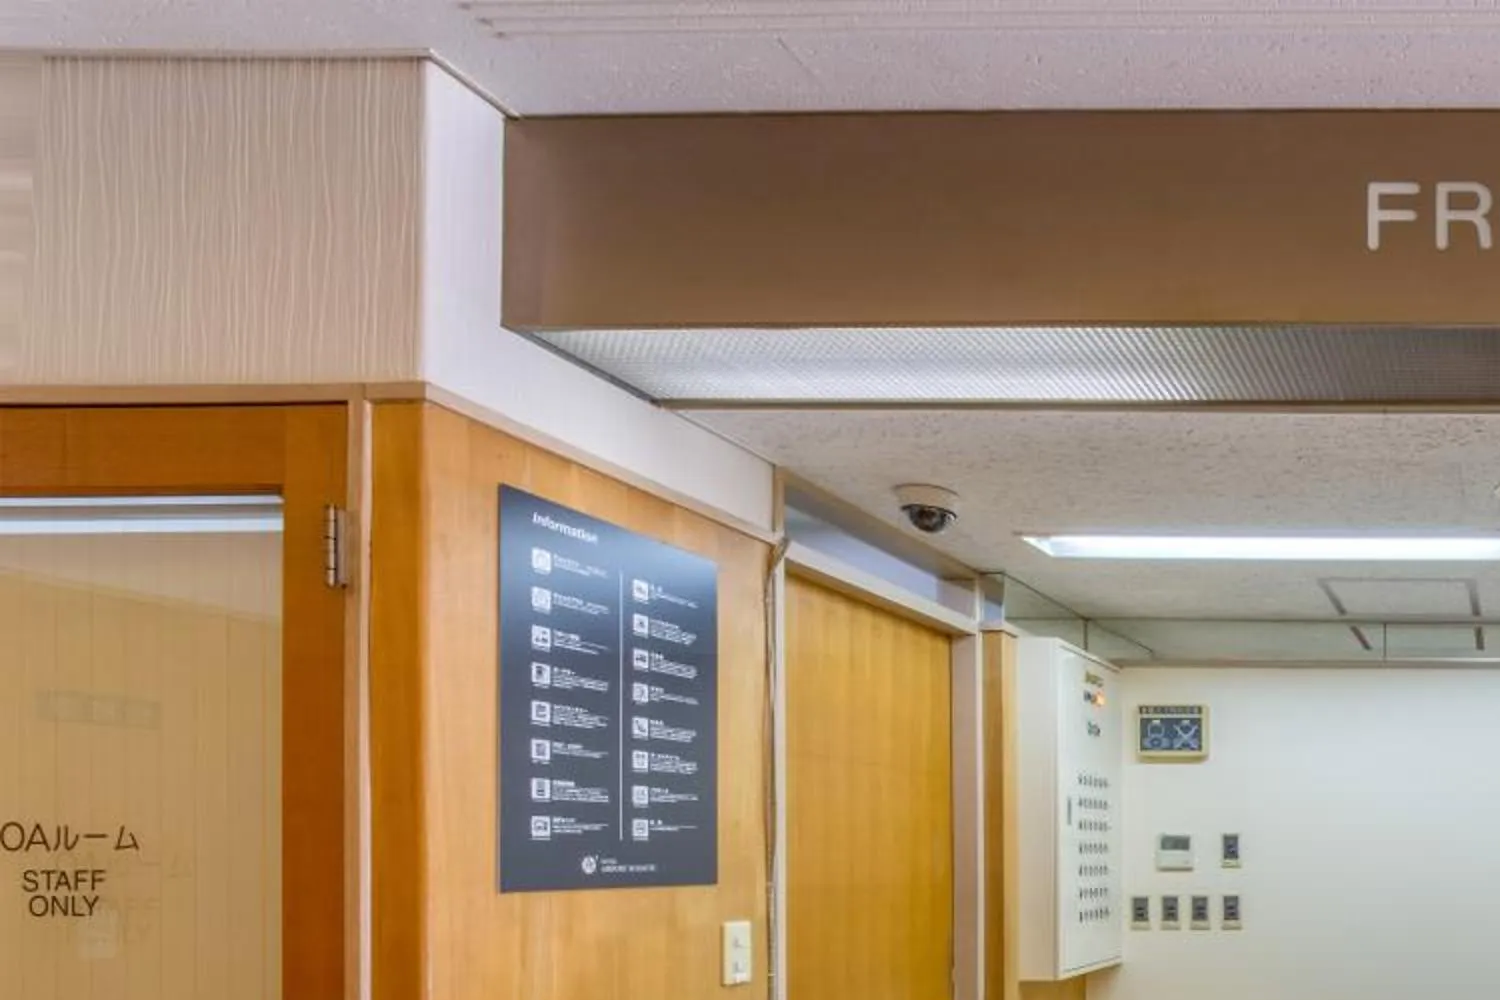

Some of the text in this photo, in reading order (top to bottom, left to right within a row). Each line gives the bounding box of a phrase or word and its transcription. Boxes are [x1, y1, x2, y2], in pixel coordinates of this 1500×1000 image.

[532, 511, 598, 544] Information
[0, 821, 140, 851] OAルーム
[22, 869, 106, 892] STAFF
[28, 895, 99, 917] ONLY
